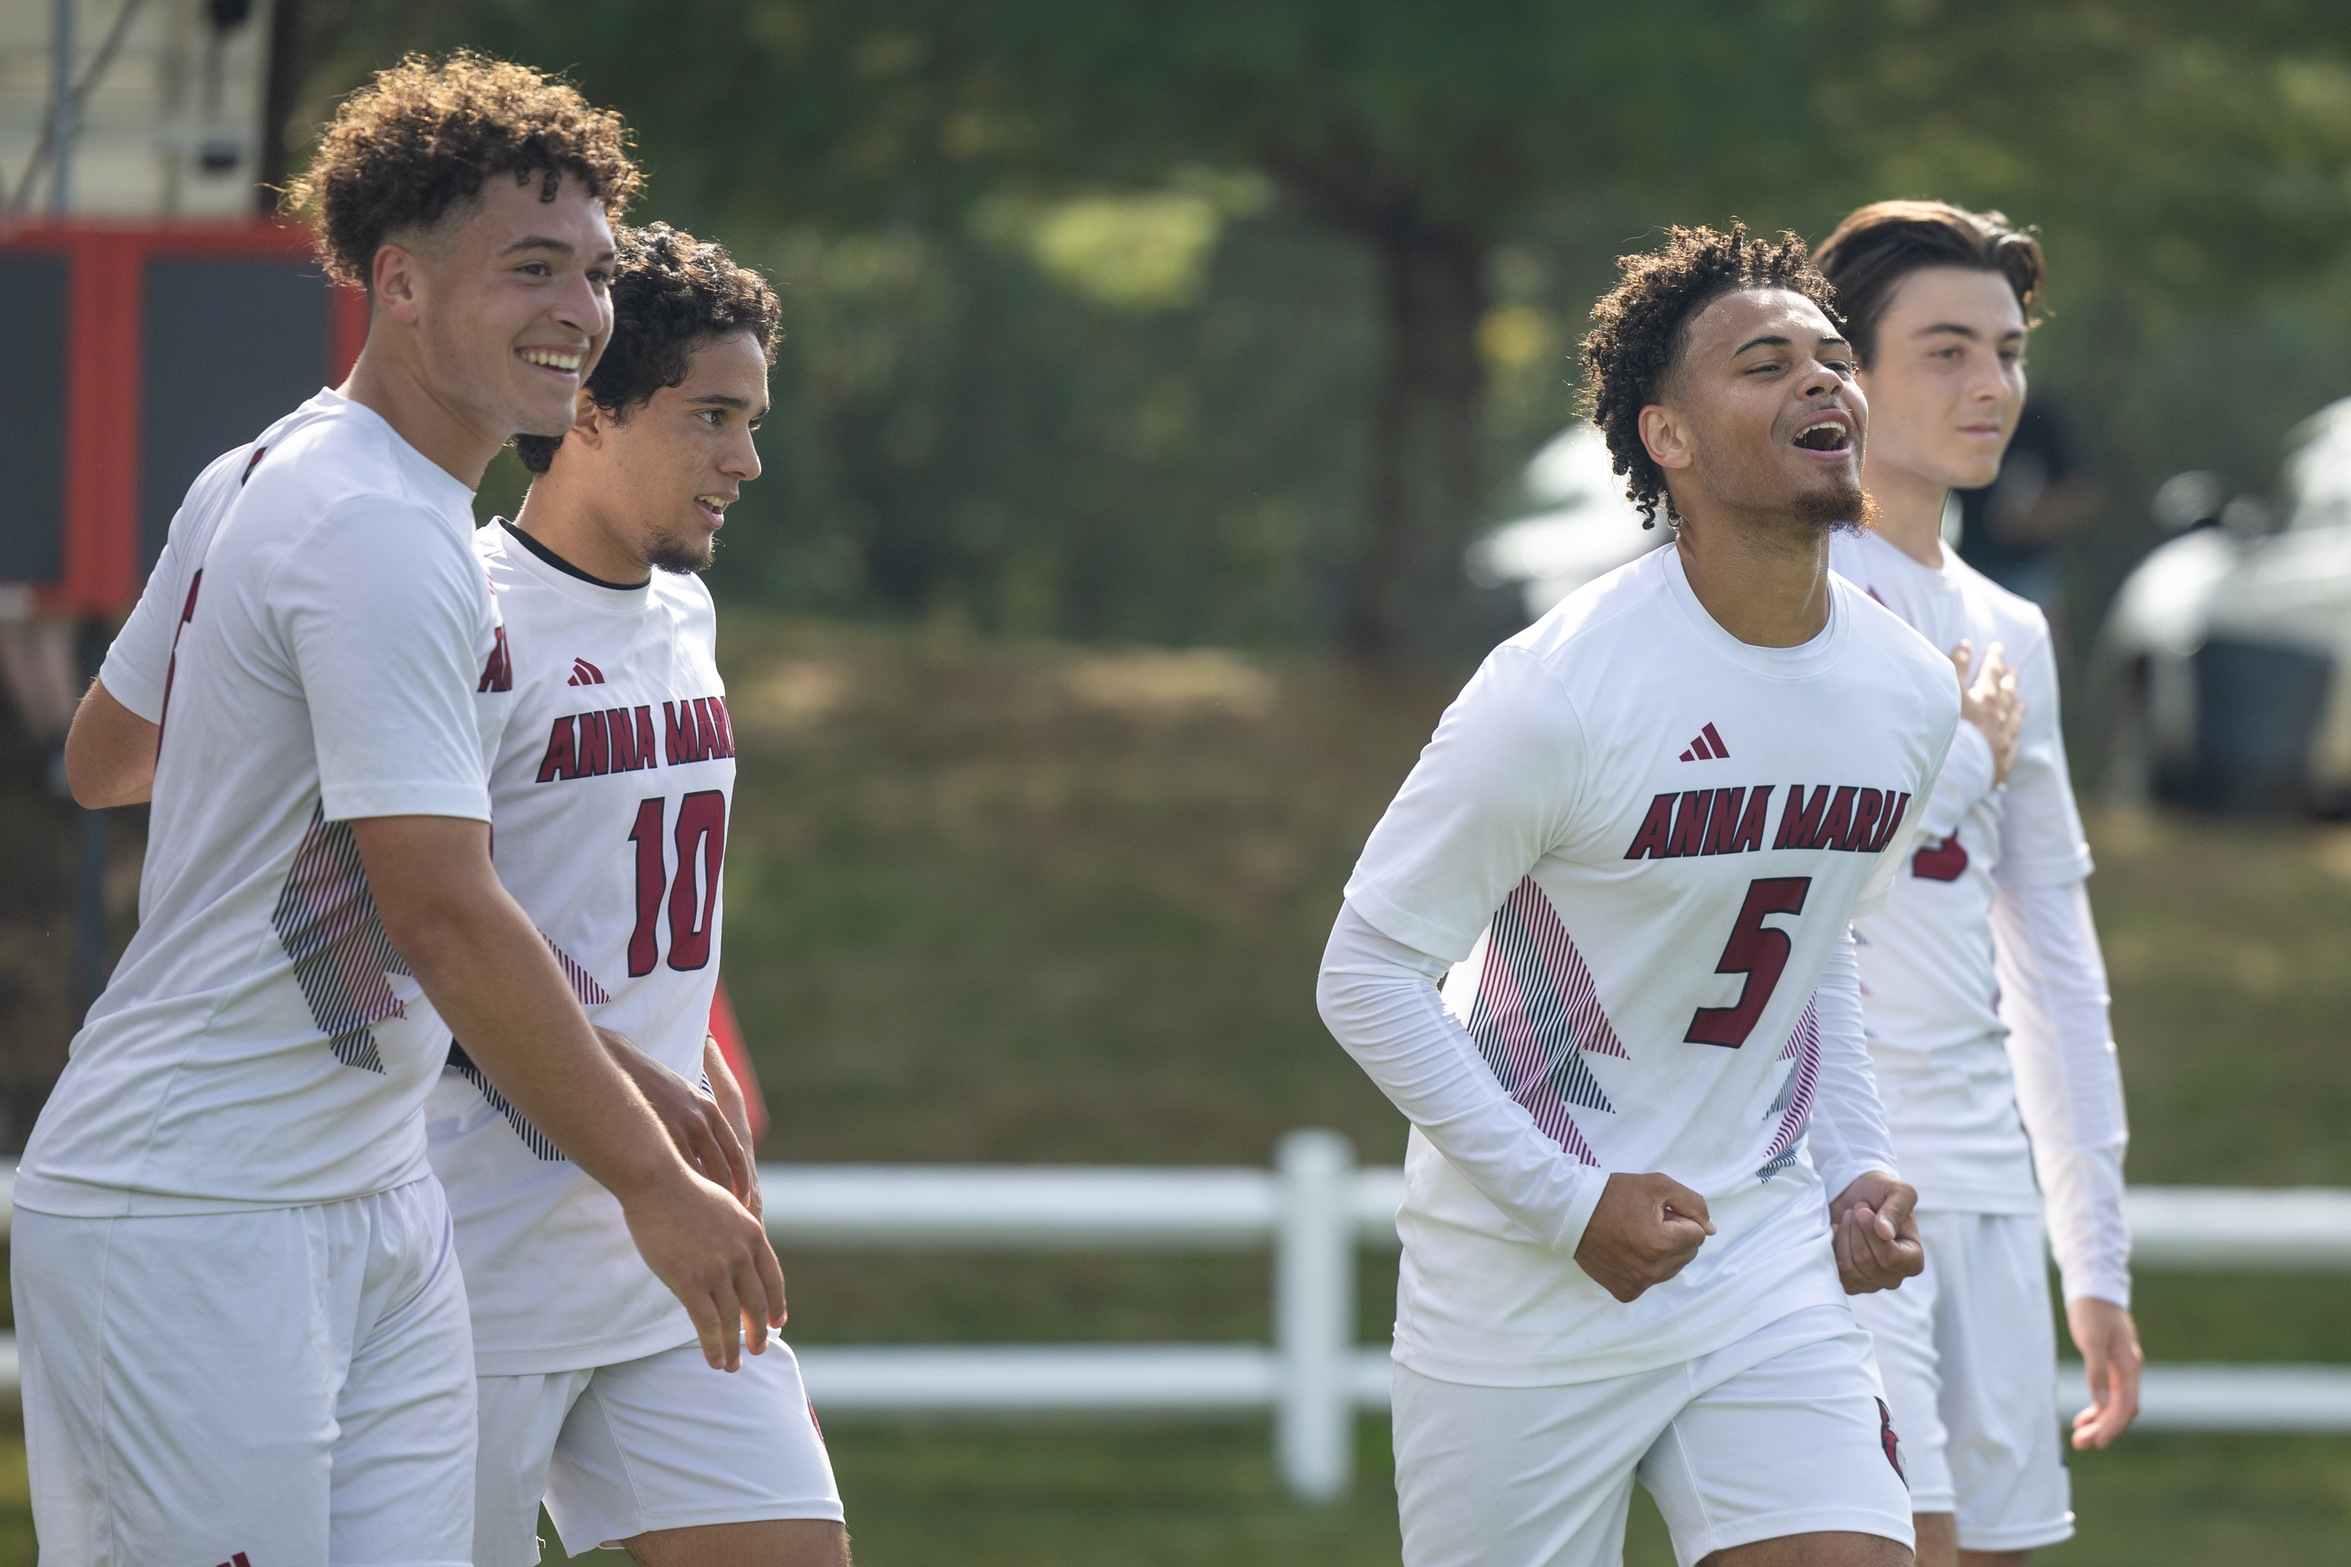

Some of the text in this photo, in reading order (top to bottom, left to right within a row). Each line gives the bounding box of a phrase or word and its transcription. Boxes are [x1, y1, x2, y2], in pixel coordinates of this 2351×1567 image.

[535, 696, 736, 783] ANNA MAR
[627, 789, 725, 978] 10
[1623, 785, 1776, 859] ANNA
[1683, 876, 1812, 1049] 5
